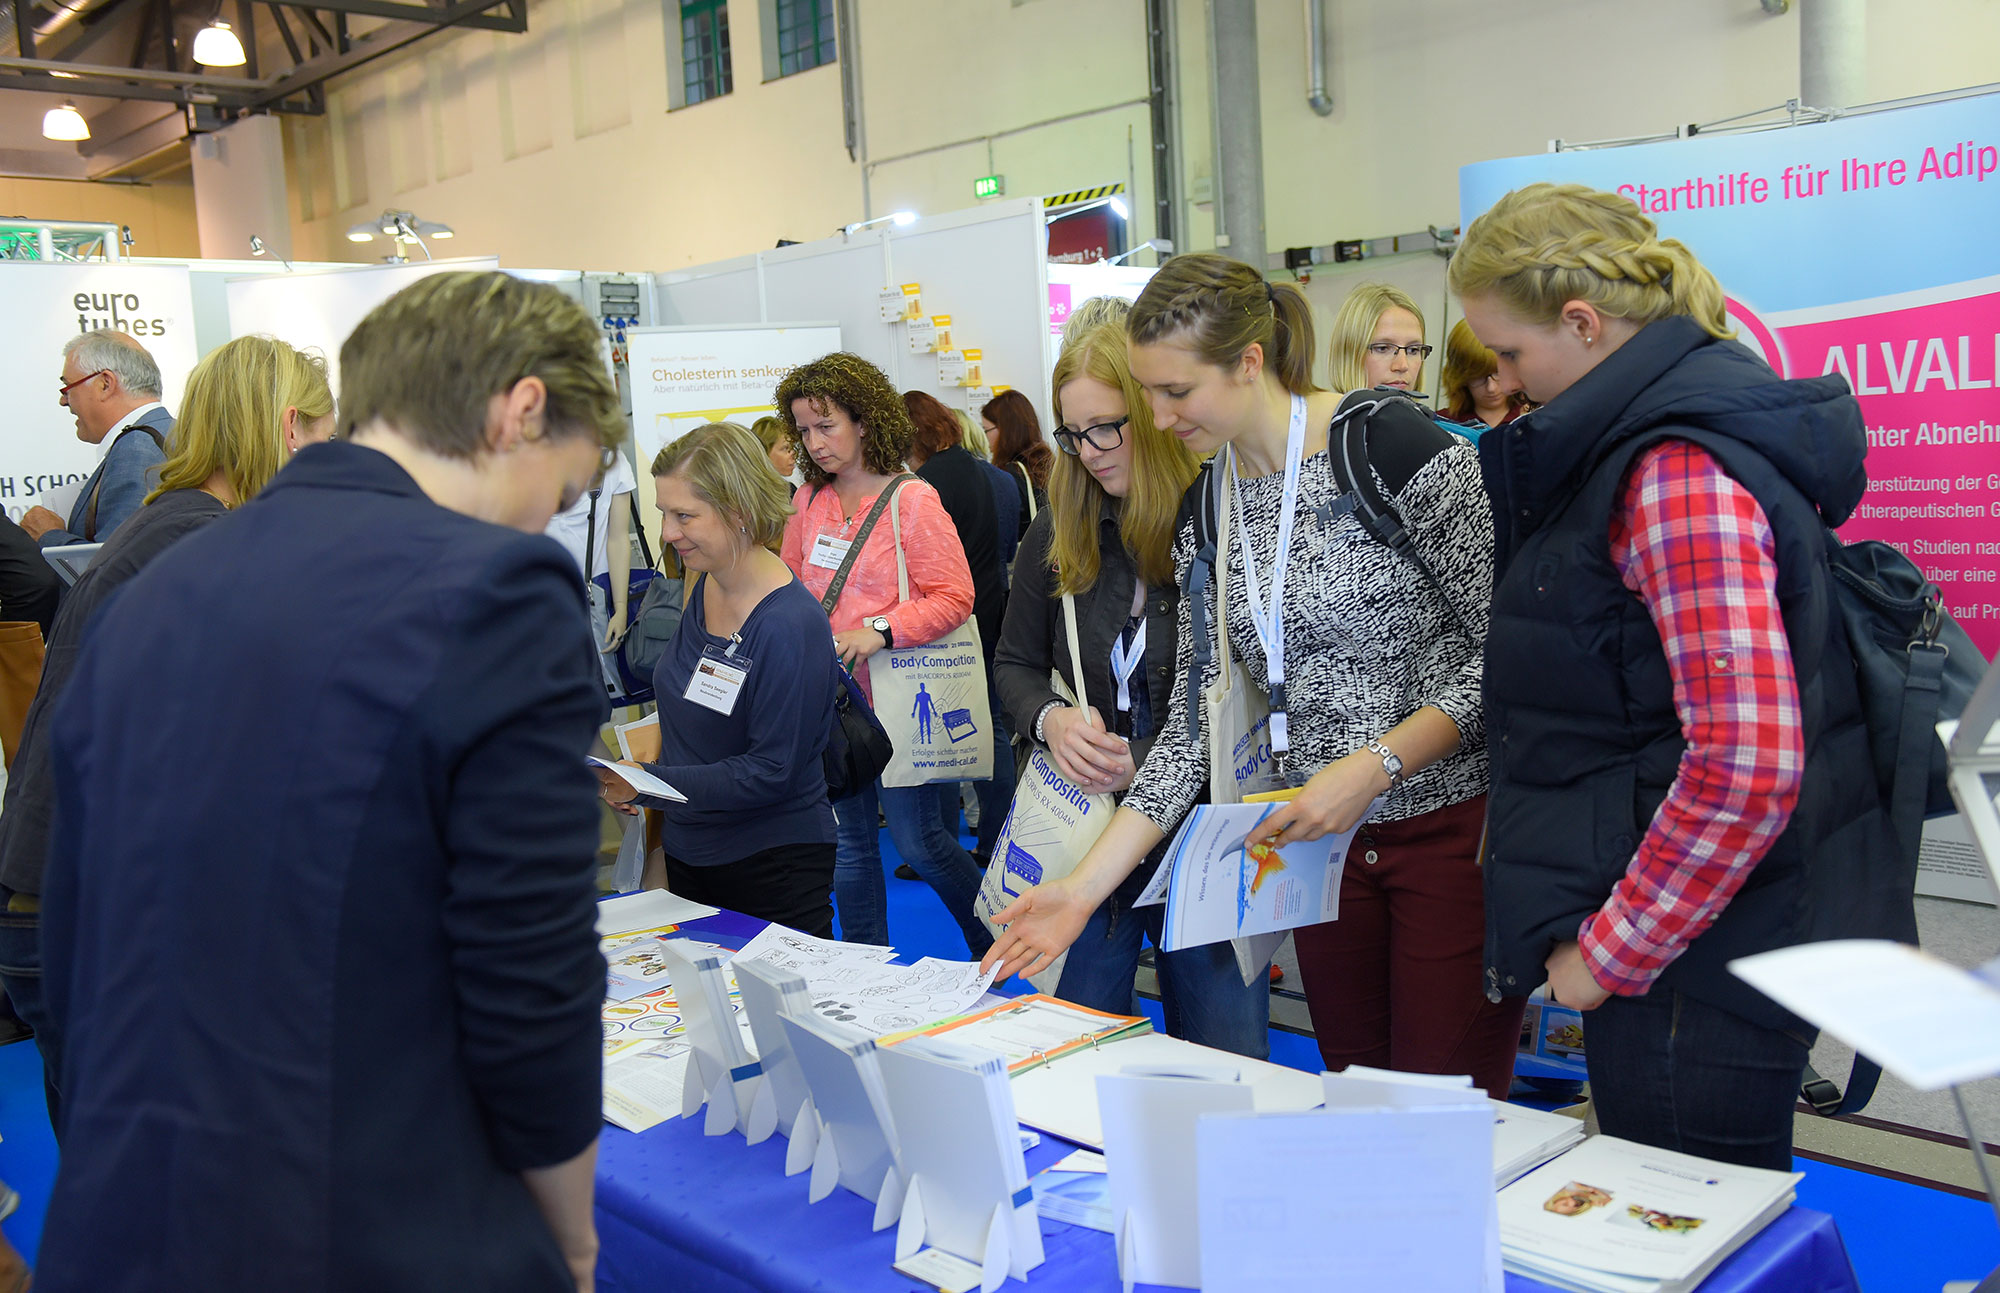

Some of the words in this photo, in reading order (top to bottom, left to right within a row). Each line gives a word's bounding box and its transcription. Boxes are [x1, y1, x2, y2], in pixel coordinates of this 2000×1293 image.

[1616, 171, 1769, 214] Starthilfe
[1781, 163, 1830, 200] für
[1841, 157, 1907, 193] Ihre
[1916, 140, 2000, 183] Adip
[73, 292, 139, 315] euro
[652, 367, 737, 382] Cholesterin
[1821, 333, 2000, 397] ALVAL
[653, 384, 675, 394] Aber
[678, 381, 720, 393] natürlich
[722, 380, 739, 391] mit
[1865, 425, 1910, 448] hter
[1915, 420, 2000, 446] Abneh
[0, 477, 16, 498] H
[1866, 475, 1950, 494] terstützung
[1955, 474, 1983, 491] der
[1860, 502, 1985, 521] therapeutischen
[1913, 538, 1970, 555] Studien
[1976, 542, 2000, 555] nac
[1926, 565, 1960, 582] über
[1963, 567, 1997, 582] eine
[1953, 603, 1978, 619] auf
[912, 748, 936, 758] Erfolge
[912, 756, 978, 769] www.medi-cal.de
[1051, 805, 1076, 828] 4004M
